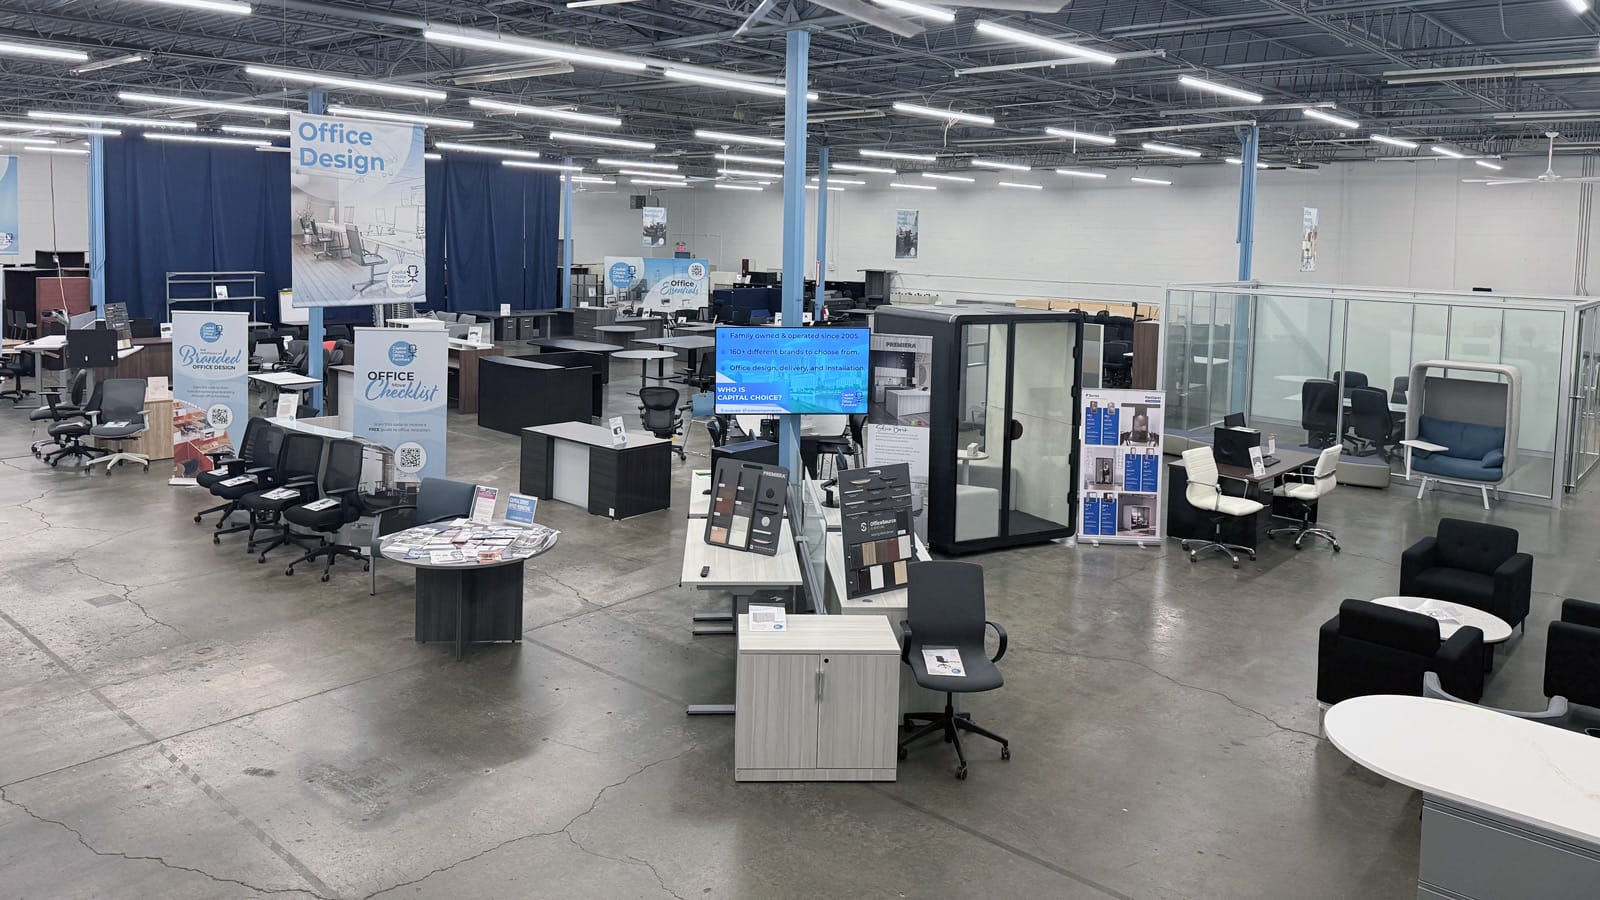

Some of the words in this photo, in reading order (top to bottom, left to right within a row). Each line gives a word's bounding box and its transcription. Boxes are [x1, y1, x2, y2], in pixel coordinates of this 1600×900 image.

[298, 121, 373, 146] Office
[299, 147, 385, 175] Design
[660, 281, 699, 296] Essentials
[670, 279, 695, 287] Office
[730, 332, 754, 340] Family
[788, 332, 820, 341] operated
[179, 344, 242, 366] Branded
[779, 365, 809, 374] delivery,
[367, 371, 415, 381] OFFICE
[364, 379, 439, 402] Checklist
[870, 518, 897, 527] OfficeSource
